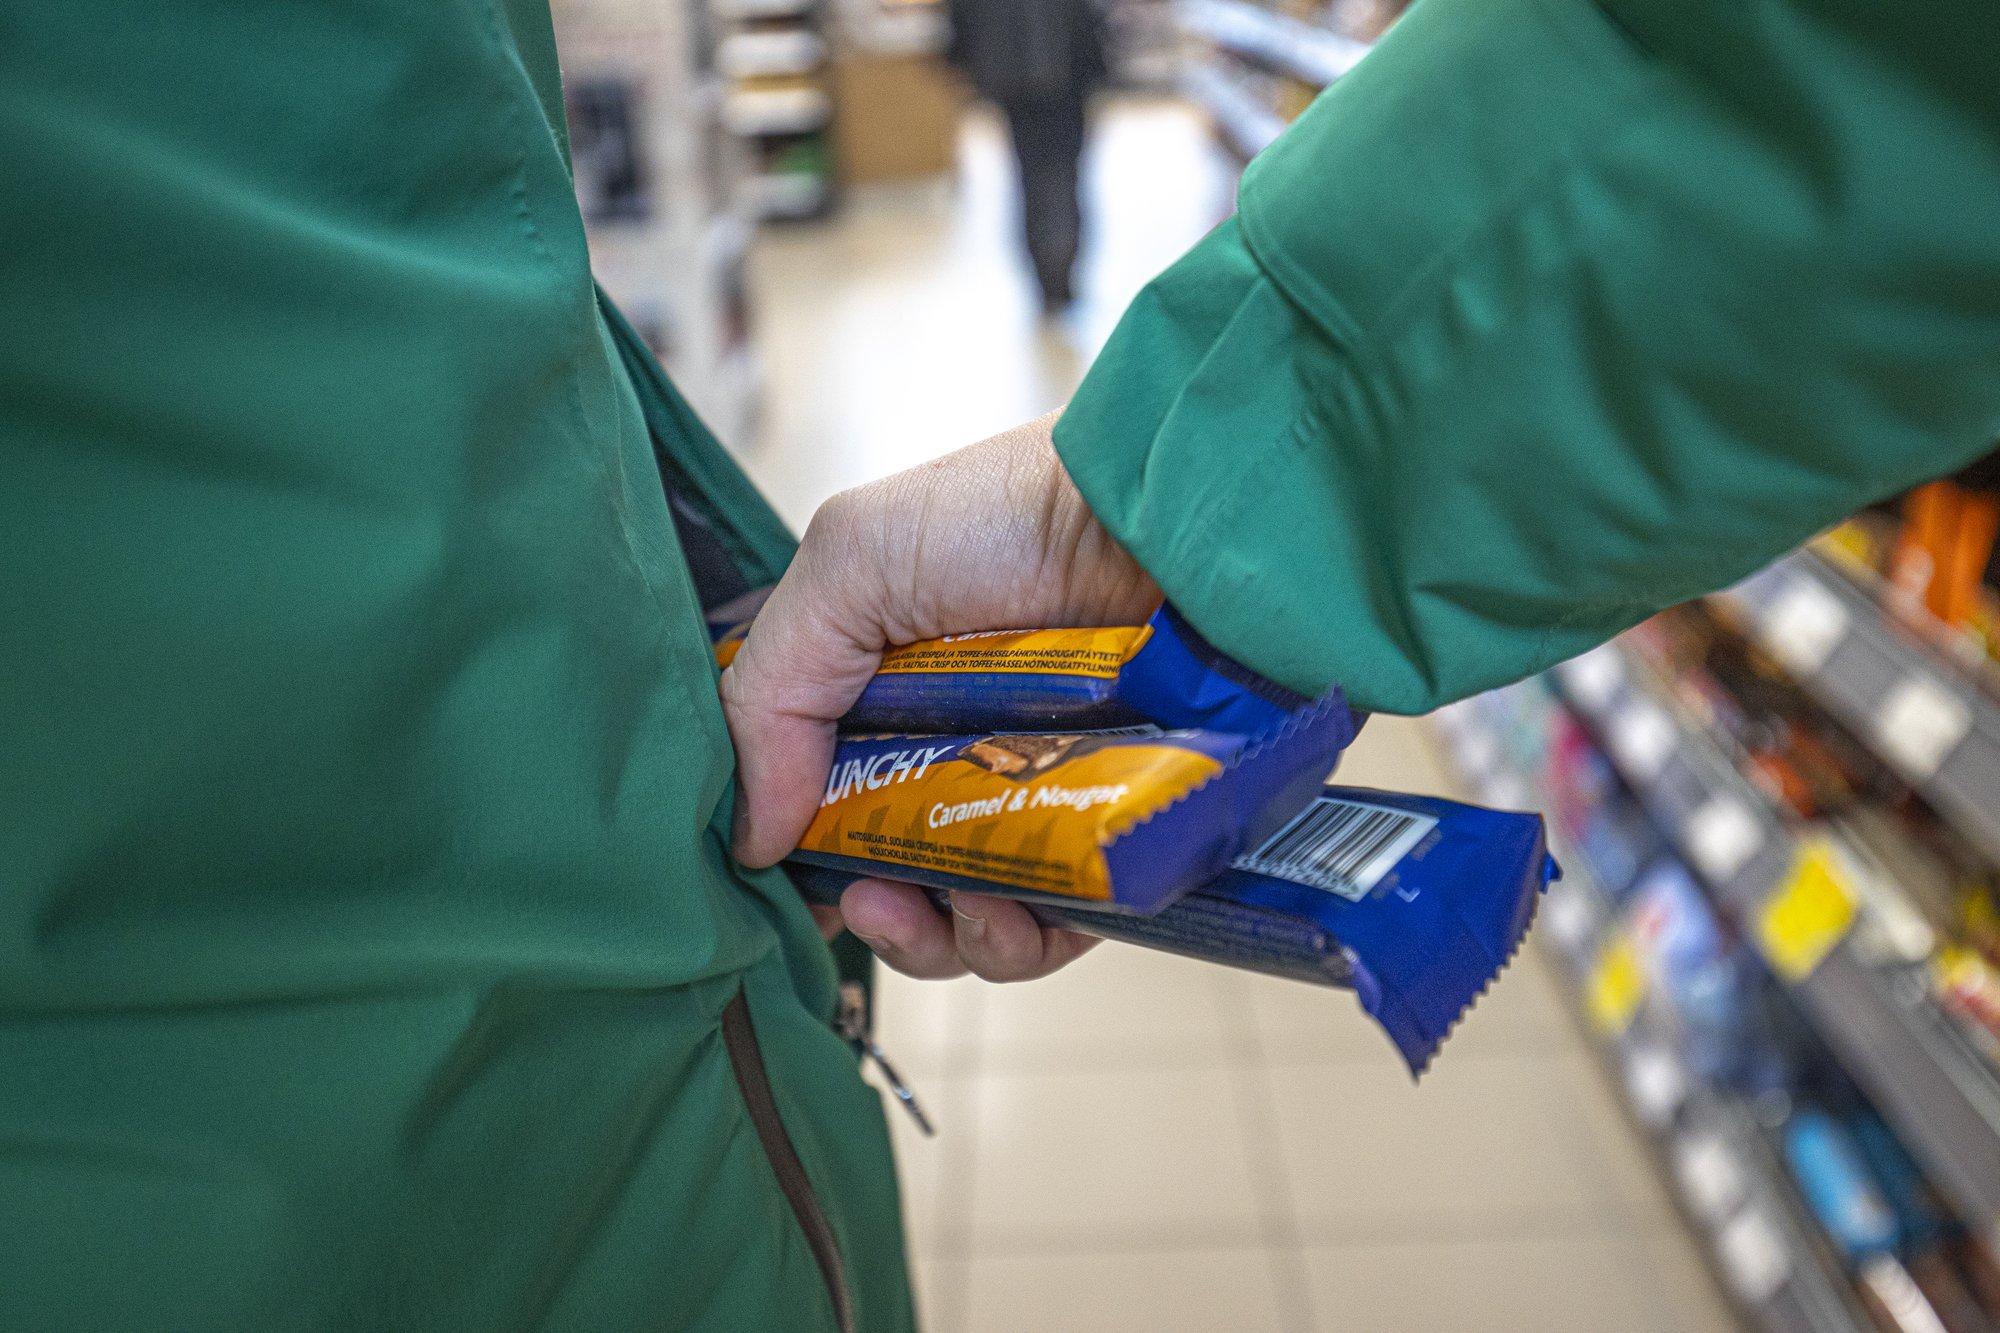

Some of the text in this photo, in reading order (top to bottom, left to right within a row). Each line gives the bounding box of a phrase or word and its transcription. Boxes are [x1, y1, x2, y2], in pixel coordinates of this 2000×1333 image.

[930, 660, 949, 669] CRISP
[951, 660, 967, 668] OCH
[956, 648, 1122, 662] TOFFEE-HASSELPÄHKINÄNOUGATTÄYTETT
[820, 744, 956, 808] UNCHY
[928, 783, 1129, 829] Caramel & Nougat
